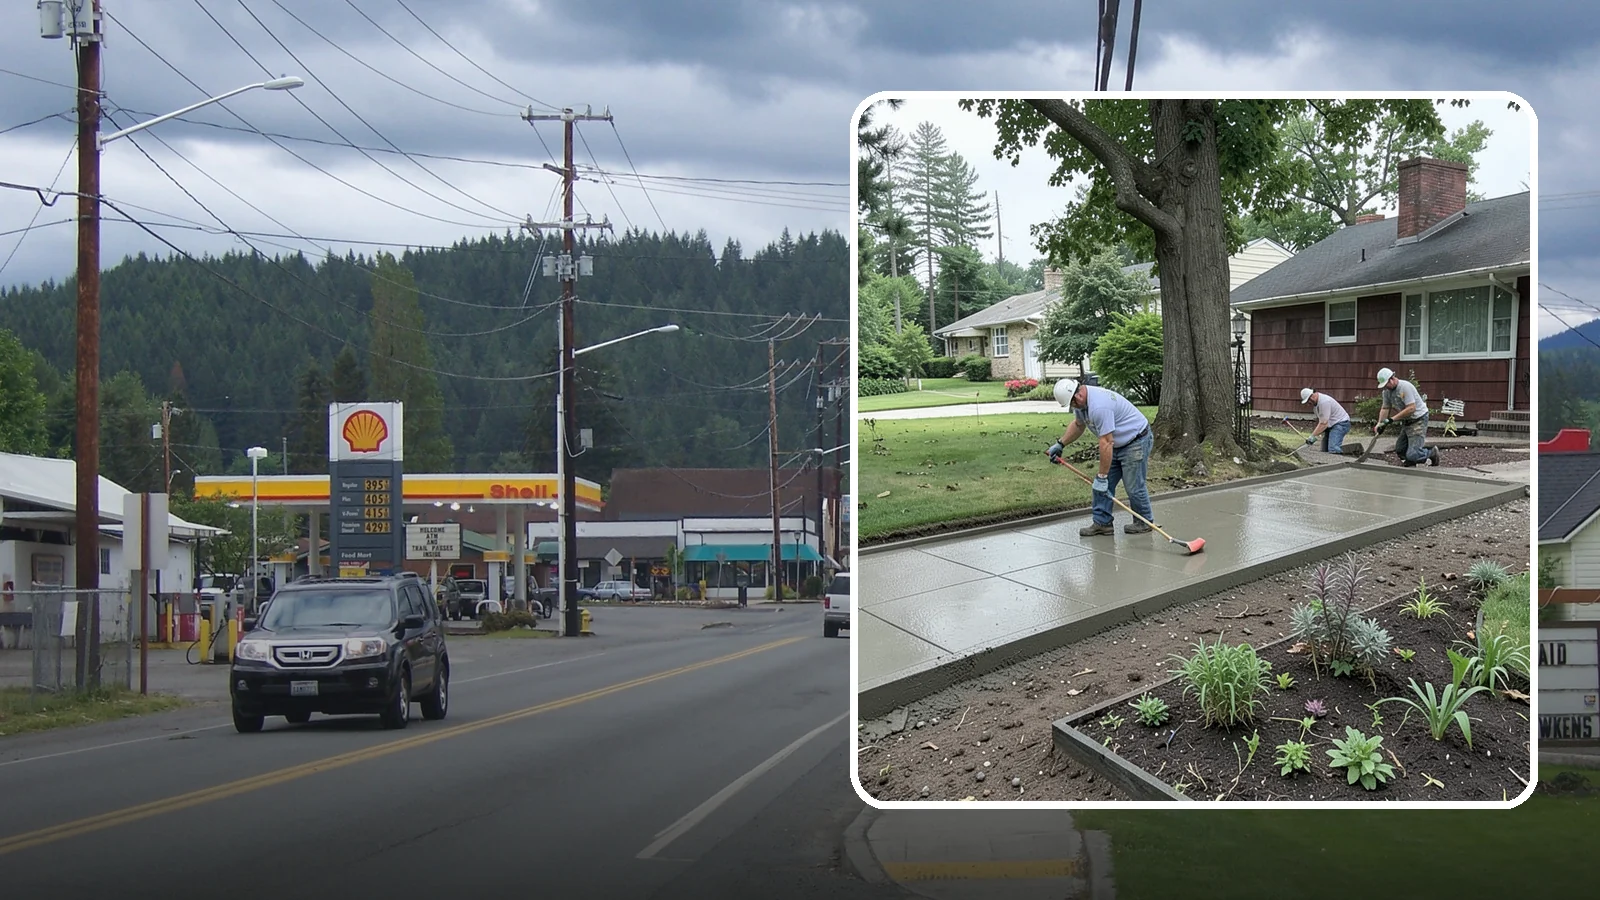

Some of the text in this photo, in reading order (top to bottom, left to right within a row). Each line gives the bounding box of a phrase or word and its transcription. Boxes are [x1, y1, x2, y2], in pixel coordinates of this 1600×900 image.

[366, 480, 384, 490] 395
[490, 484, 547, 499] Shell
[366, 494, 384, 504] 405
[366, 508, 384, 518] 415
[366, 522, 384, 532] 429
[1538, 642, 1566, 665] AID
